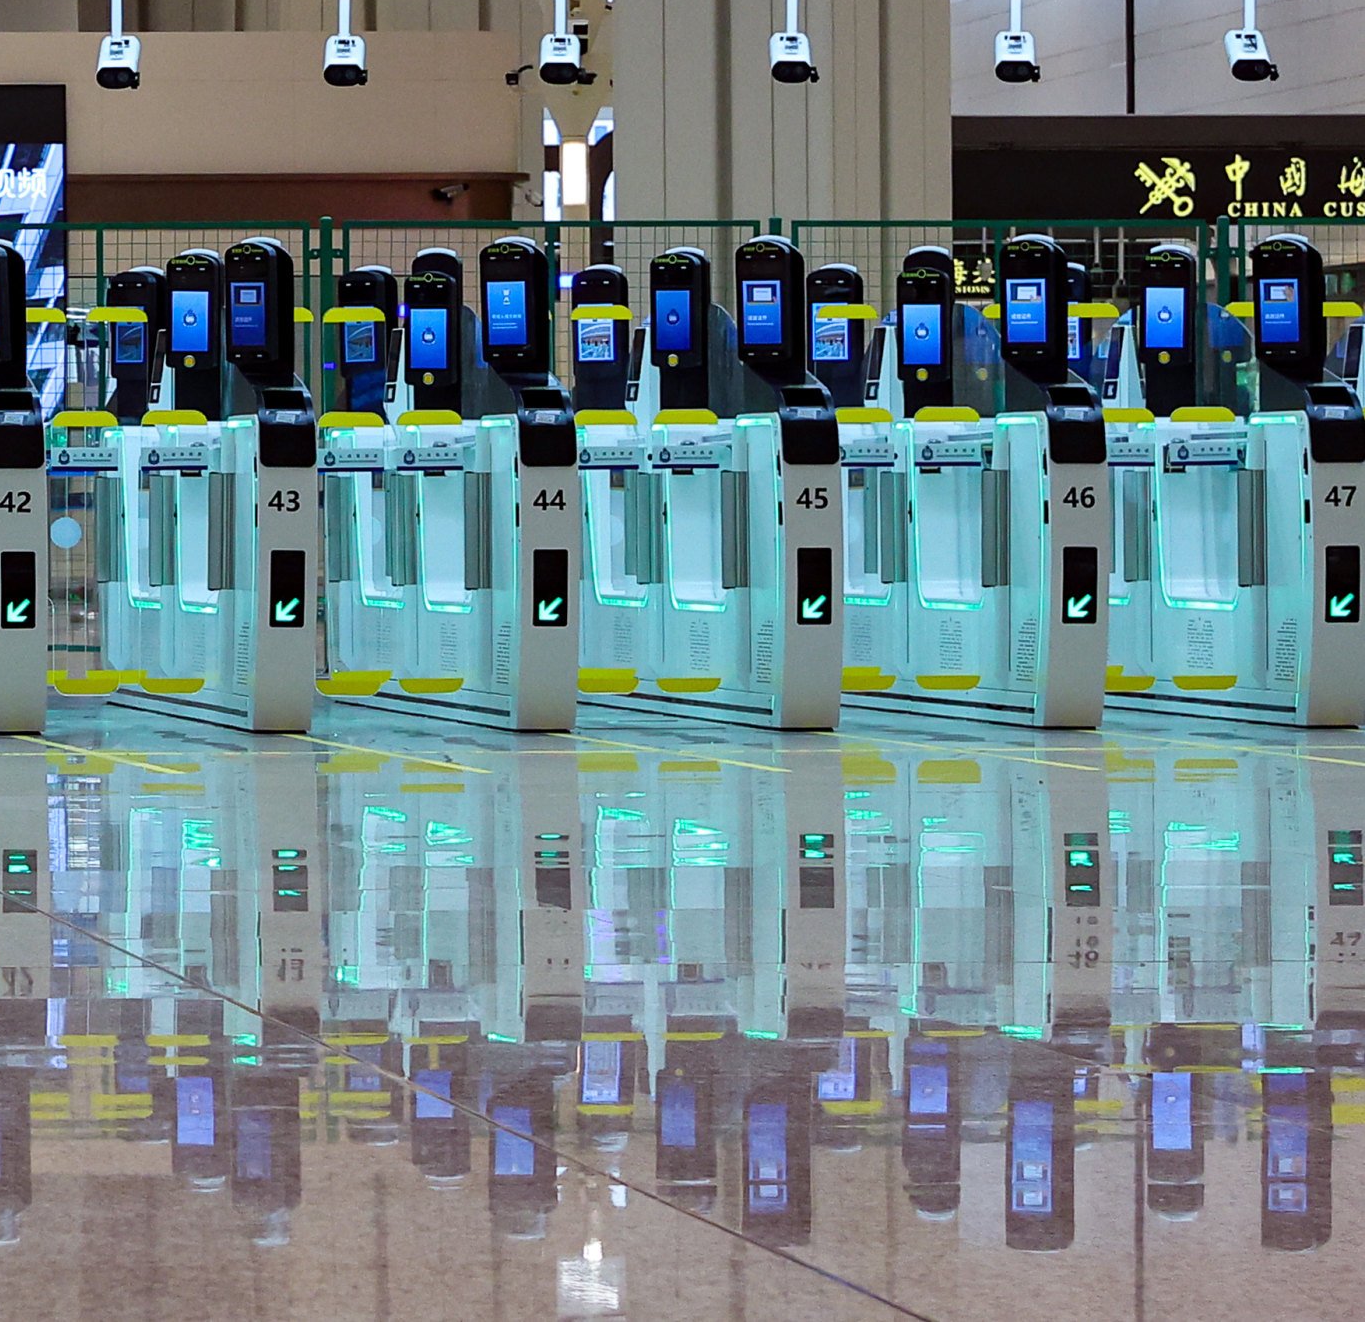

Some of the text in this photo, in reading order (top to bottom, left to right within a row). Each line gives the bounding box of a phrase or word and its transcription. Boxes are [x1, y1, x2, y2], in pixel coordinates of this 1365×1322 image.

[1227, 202, 1304, 218] CHINA
[267, 490, 301, 512] 43
[532, 489, 567, 511] 44
[796, 487, 829, 510] 45
[1062, 486, 1096, 509] 46
[1324, 485, 1357, 507] 47
